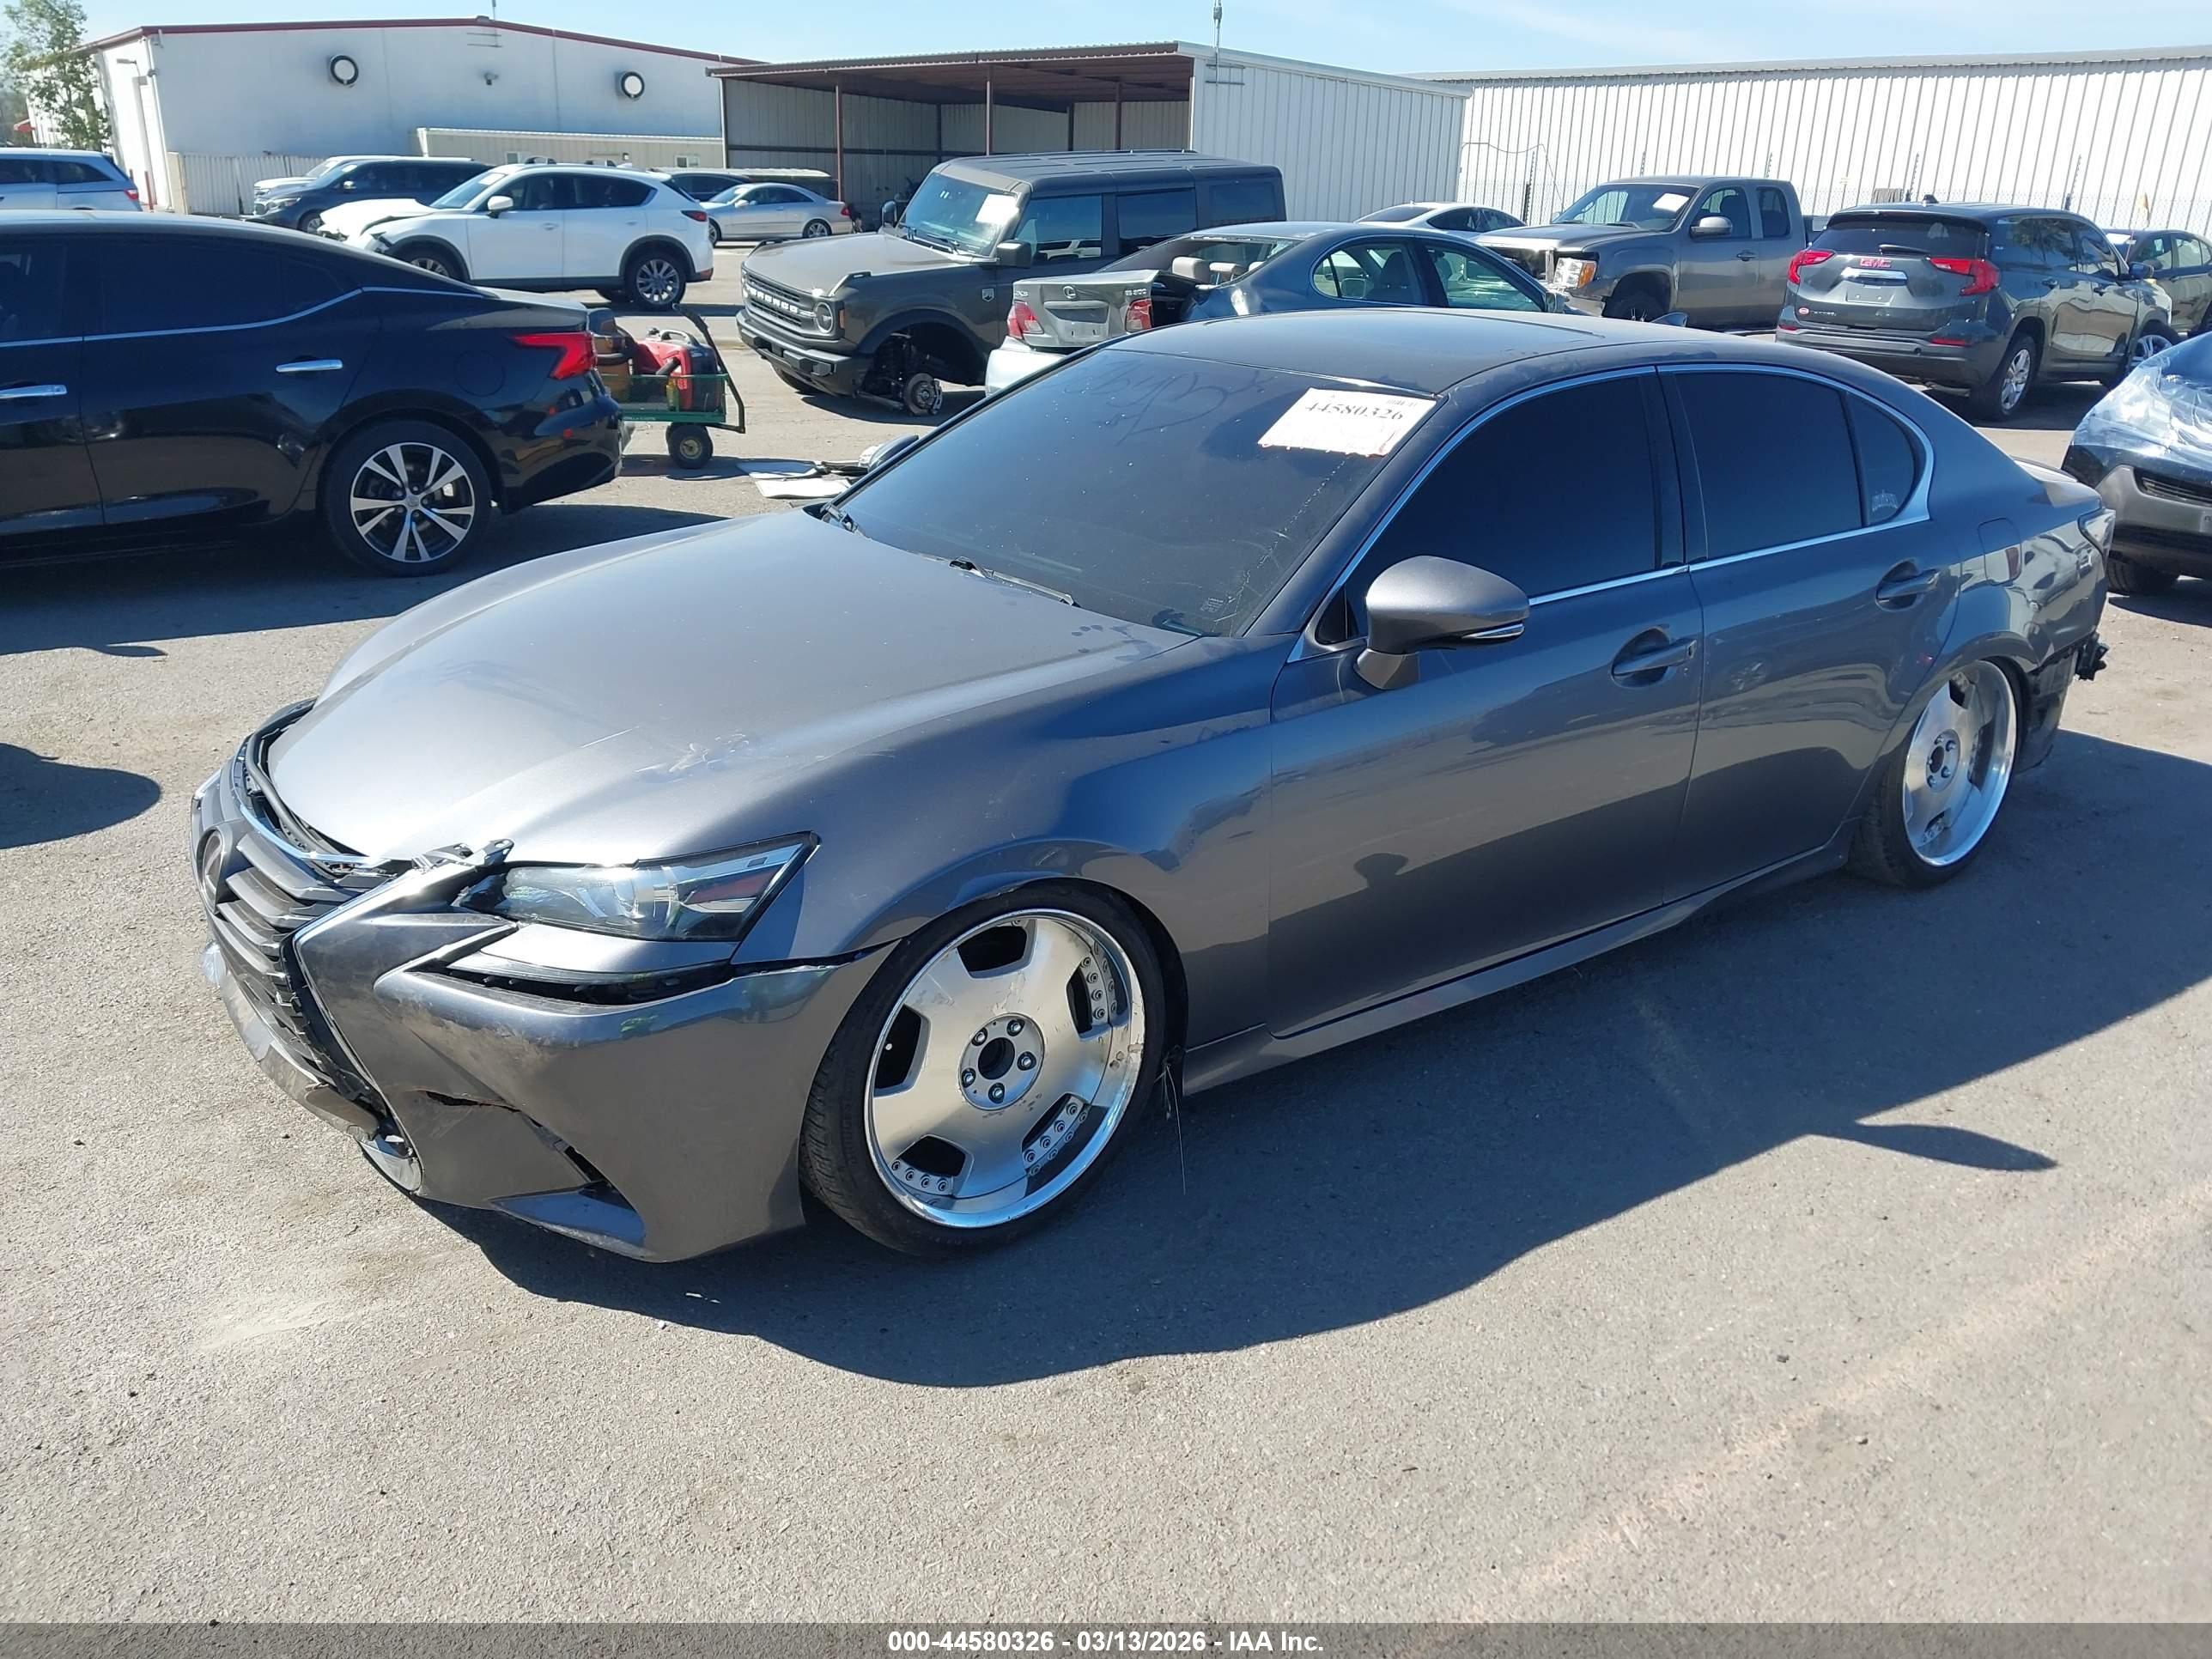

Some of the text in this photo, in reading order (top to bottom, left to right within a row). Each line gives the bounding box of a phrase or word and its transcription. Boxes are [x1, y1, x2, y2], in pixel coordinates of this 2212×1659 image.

[1860, 258, 1892, 268] GMC
[750, 288, 798, 313] BRONCO
[1305, 402, 1403, 420] 44580326
